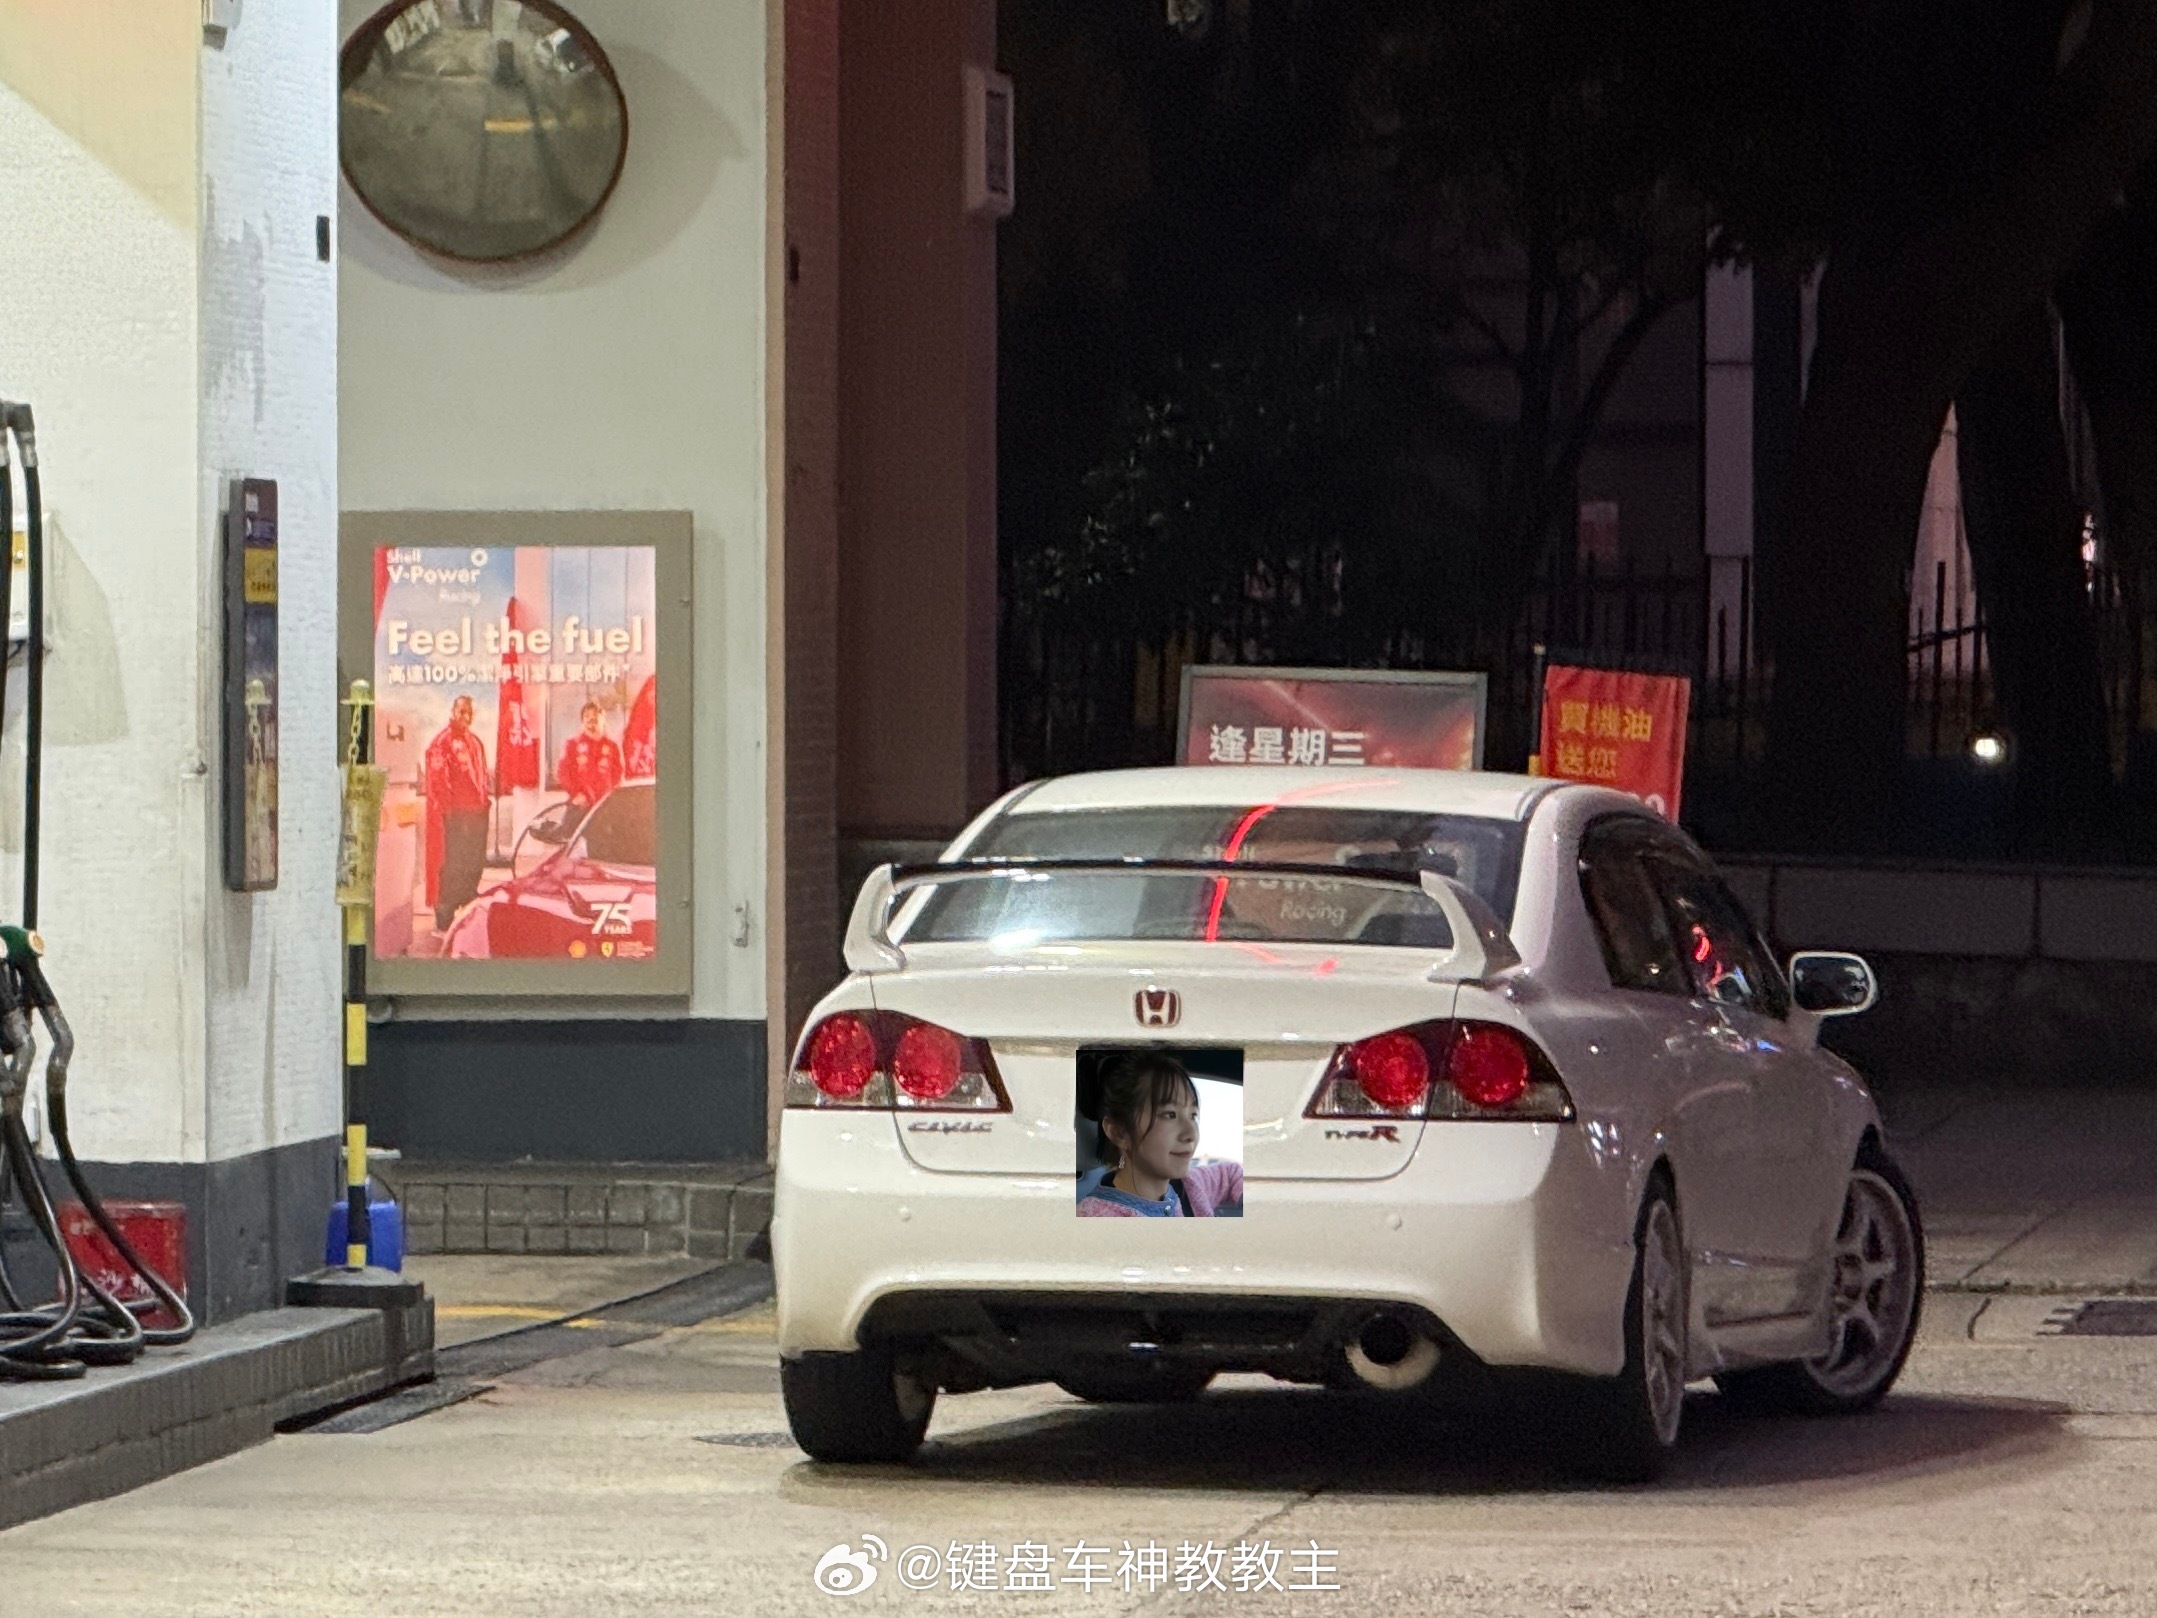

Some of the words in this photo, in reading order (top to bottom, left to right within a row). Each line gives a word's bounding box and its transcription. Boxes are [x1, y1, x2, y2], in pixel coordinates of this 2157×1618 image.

[387, 564, 481, 584] V-Power
[388, 616, 472, 655] Feel
[484, 614, 551, 655] the
[562, 614, 643, 654] fuel
[1209, 724, 1365, 766] 逢星期三
[1202, 844, 1256, 861] Shll
[591, 903, 632, 935] 75
